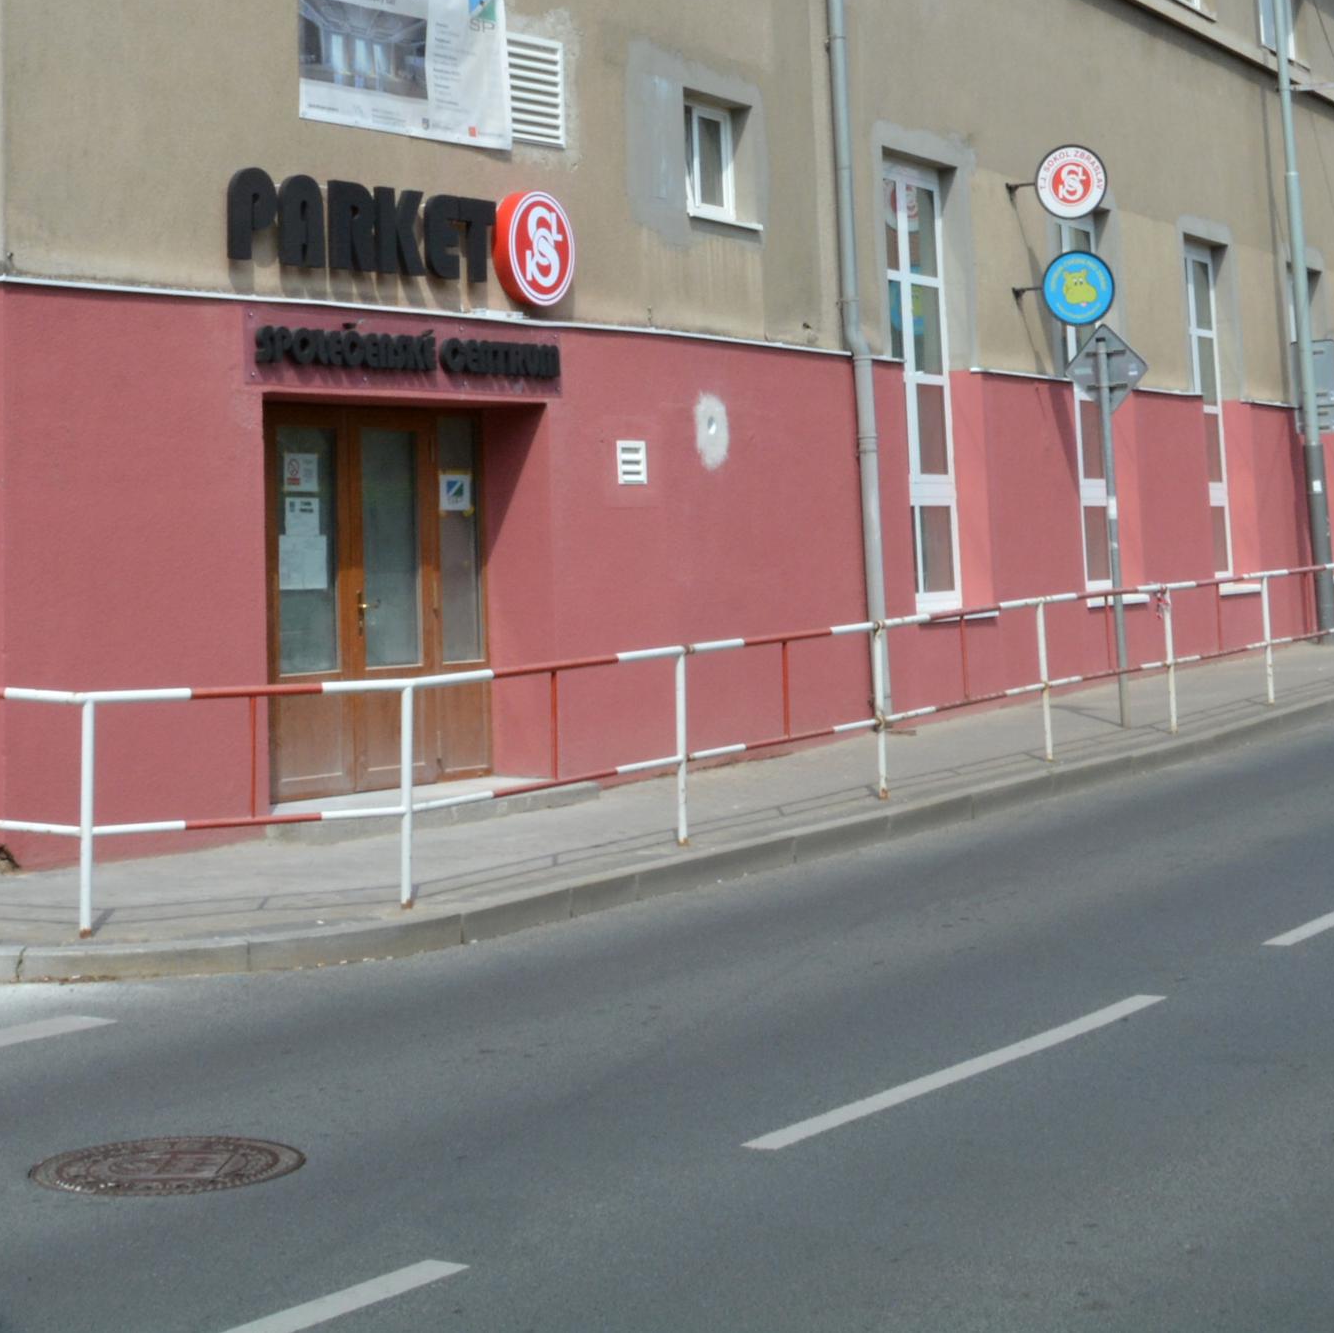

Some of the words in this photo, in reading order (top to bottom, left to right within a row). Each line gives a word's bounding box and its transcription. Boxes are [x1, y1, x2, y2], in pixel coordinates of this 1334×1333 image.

[468, 18, 496, 33] SP
[1043, 150, 1072, 174] SOKOL
[1074, 150, 1104, 191] ZBRASLAV
[227, 166, 497, 283] PARKET
